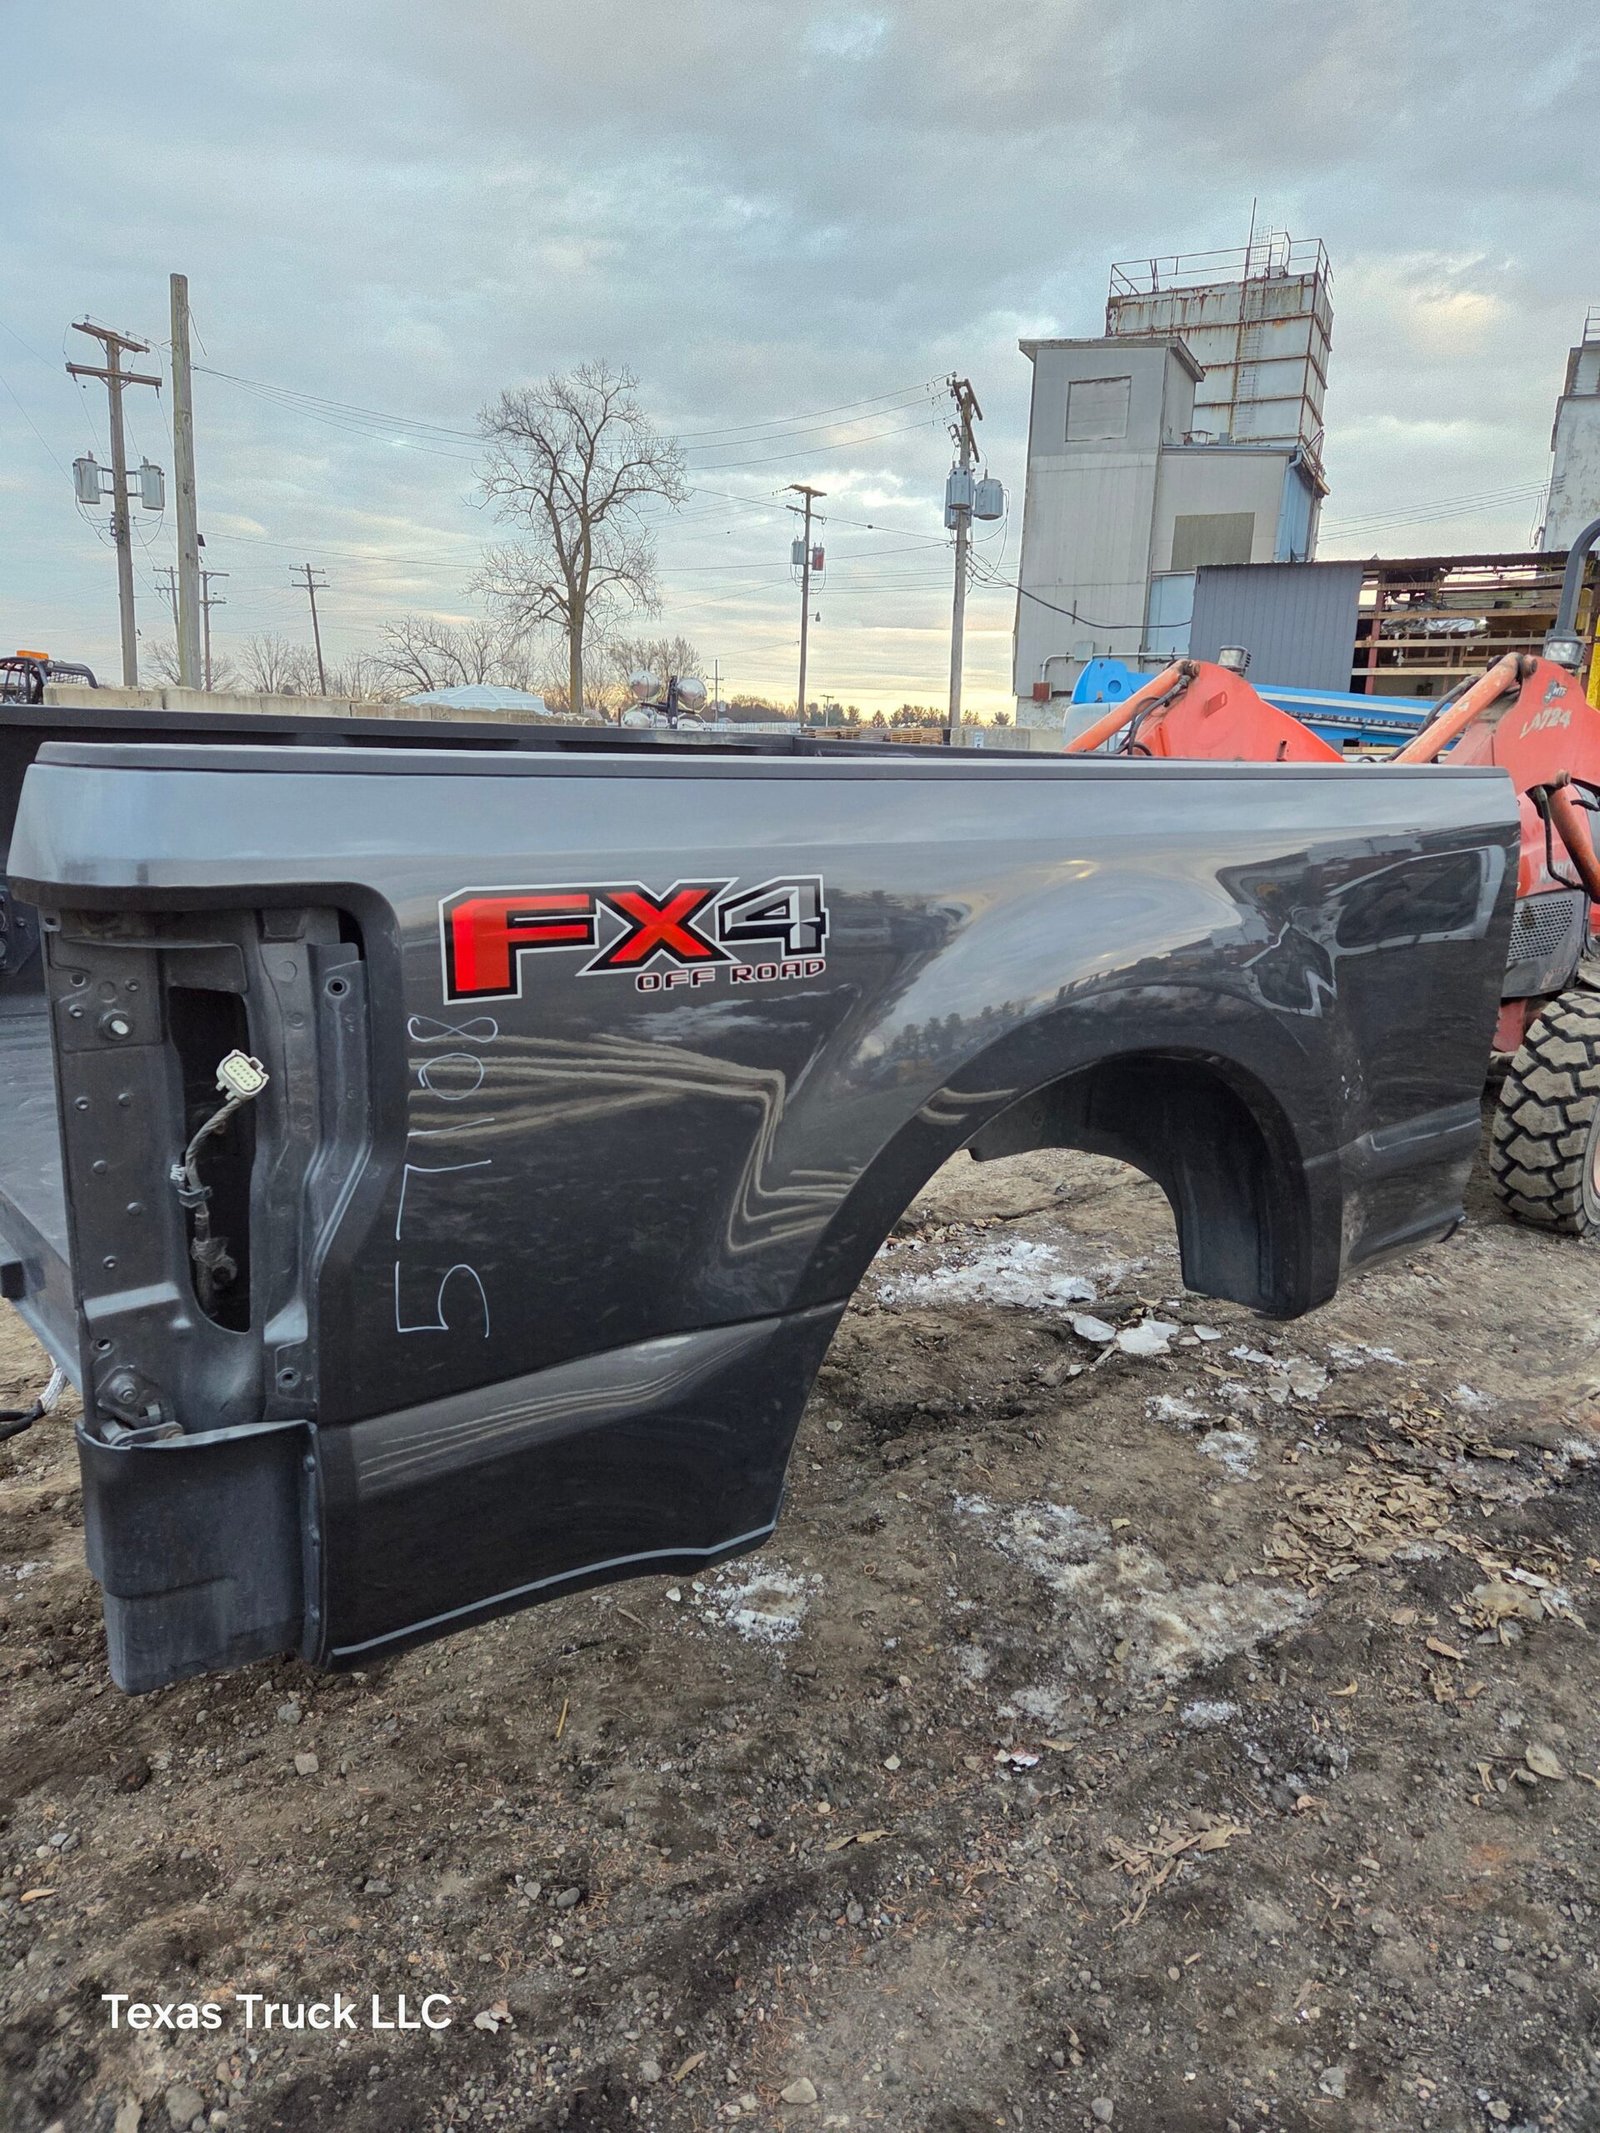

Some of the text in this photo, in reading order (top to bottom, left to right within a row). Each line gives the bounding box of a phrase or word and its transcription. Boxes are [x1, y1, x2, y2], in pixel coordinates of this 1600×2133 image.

[438, 874, 829, 1005] FX4
[635, 959, 826, 993] OFF ROAD
